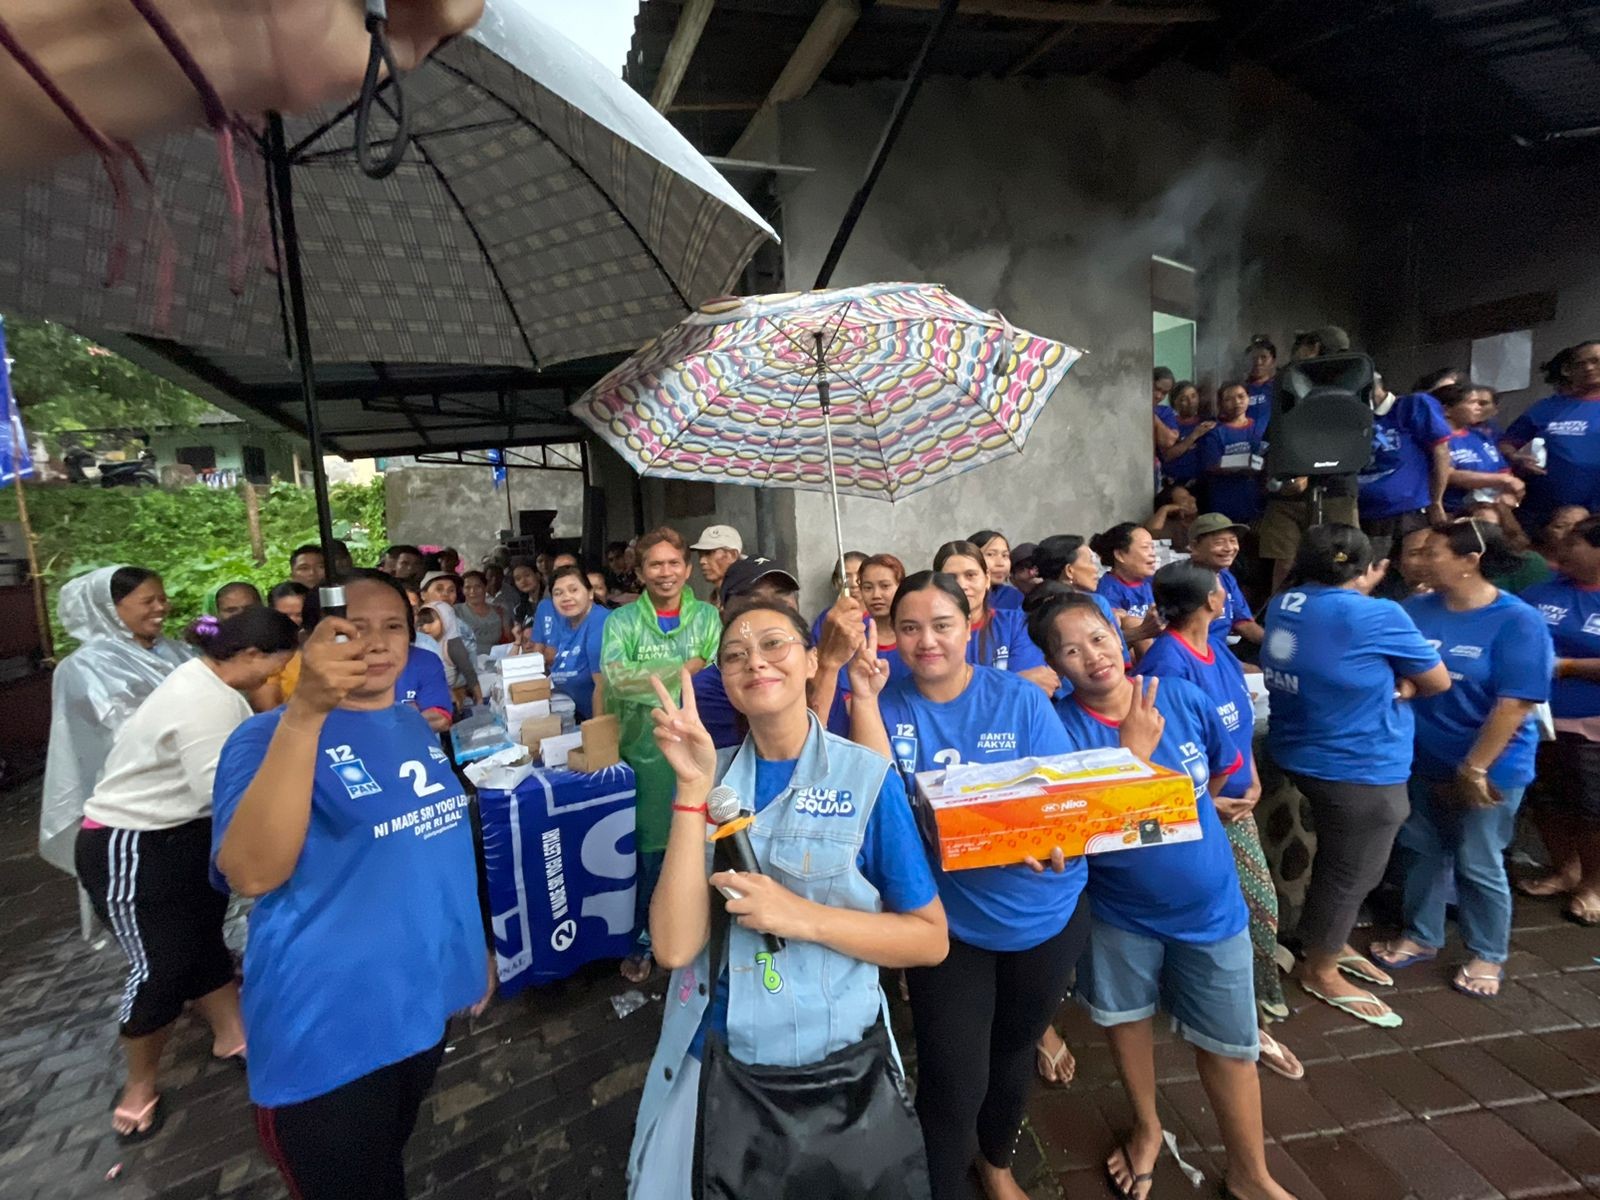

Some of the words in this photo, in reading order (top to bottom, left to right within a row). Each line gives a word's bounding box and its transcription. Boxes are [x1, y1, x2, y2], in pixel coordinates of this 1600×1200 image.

[1280, 592, 1307, 613] 12
[637, 652, 669, 660] RAKYA
[996, 645, 1009, 655] 12
[1265, 667, 1299, 691] PAN
[895, 723, 915, 737] 12
[980, 732, 1015, 741] BANTU
[325, 744, 355, 763] 12
[977, 741, 1017, 749] RAKYAT
[1179, 742, 1199, 757] 12
[399, 760, 446, 798] 2
[350, 782, 379, 797] PAN
[797, 786, 839, 801] BLUE
[795, 797, 854, 816] SQUAD
[373, 823, 389, 839] NI
[391, 813, 420, 833] MADE
[420, 804, 435, 821] SRI
[434, 796, 456, 815] YOGI
[414, 820, 432, 836] DPR
[433, 815, 443, 827] RI
[555, 922, 574, 946] 2
